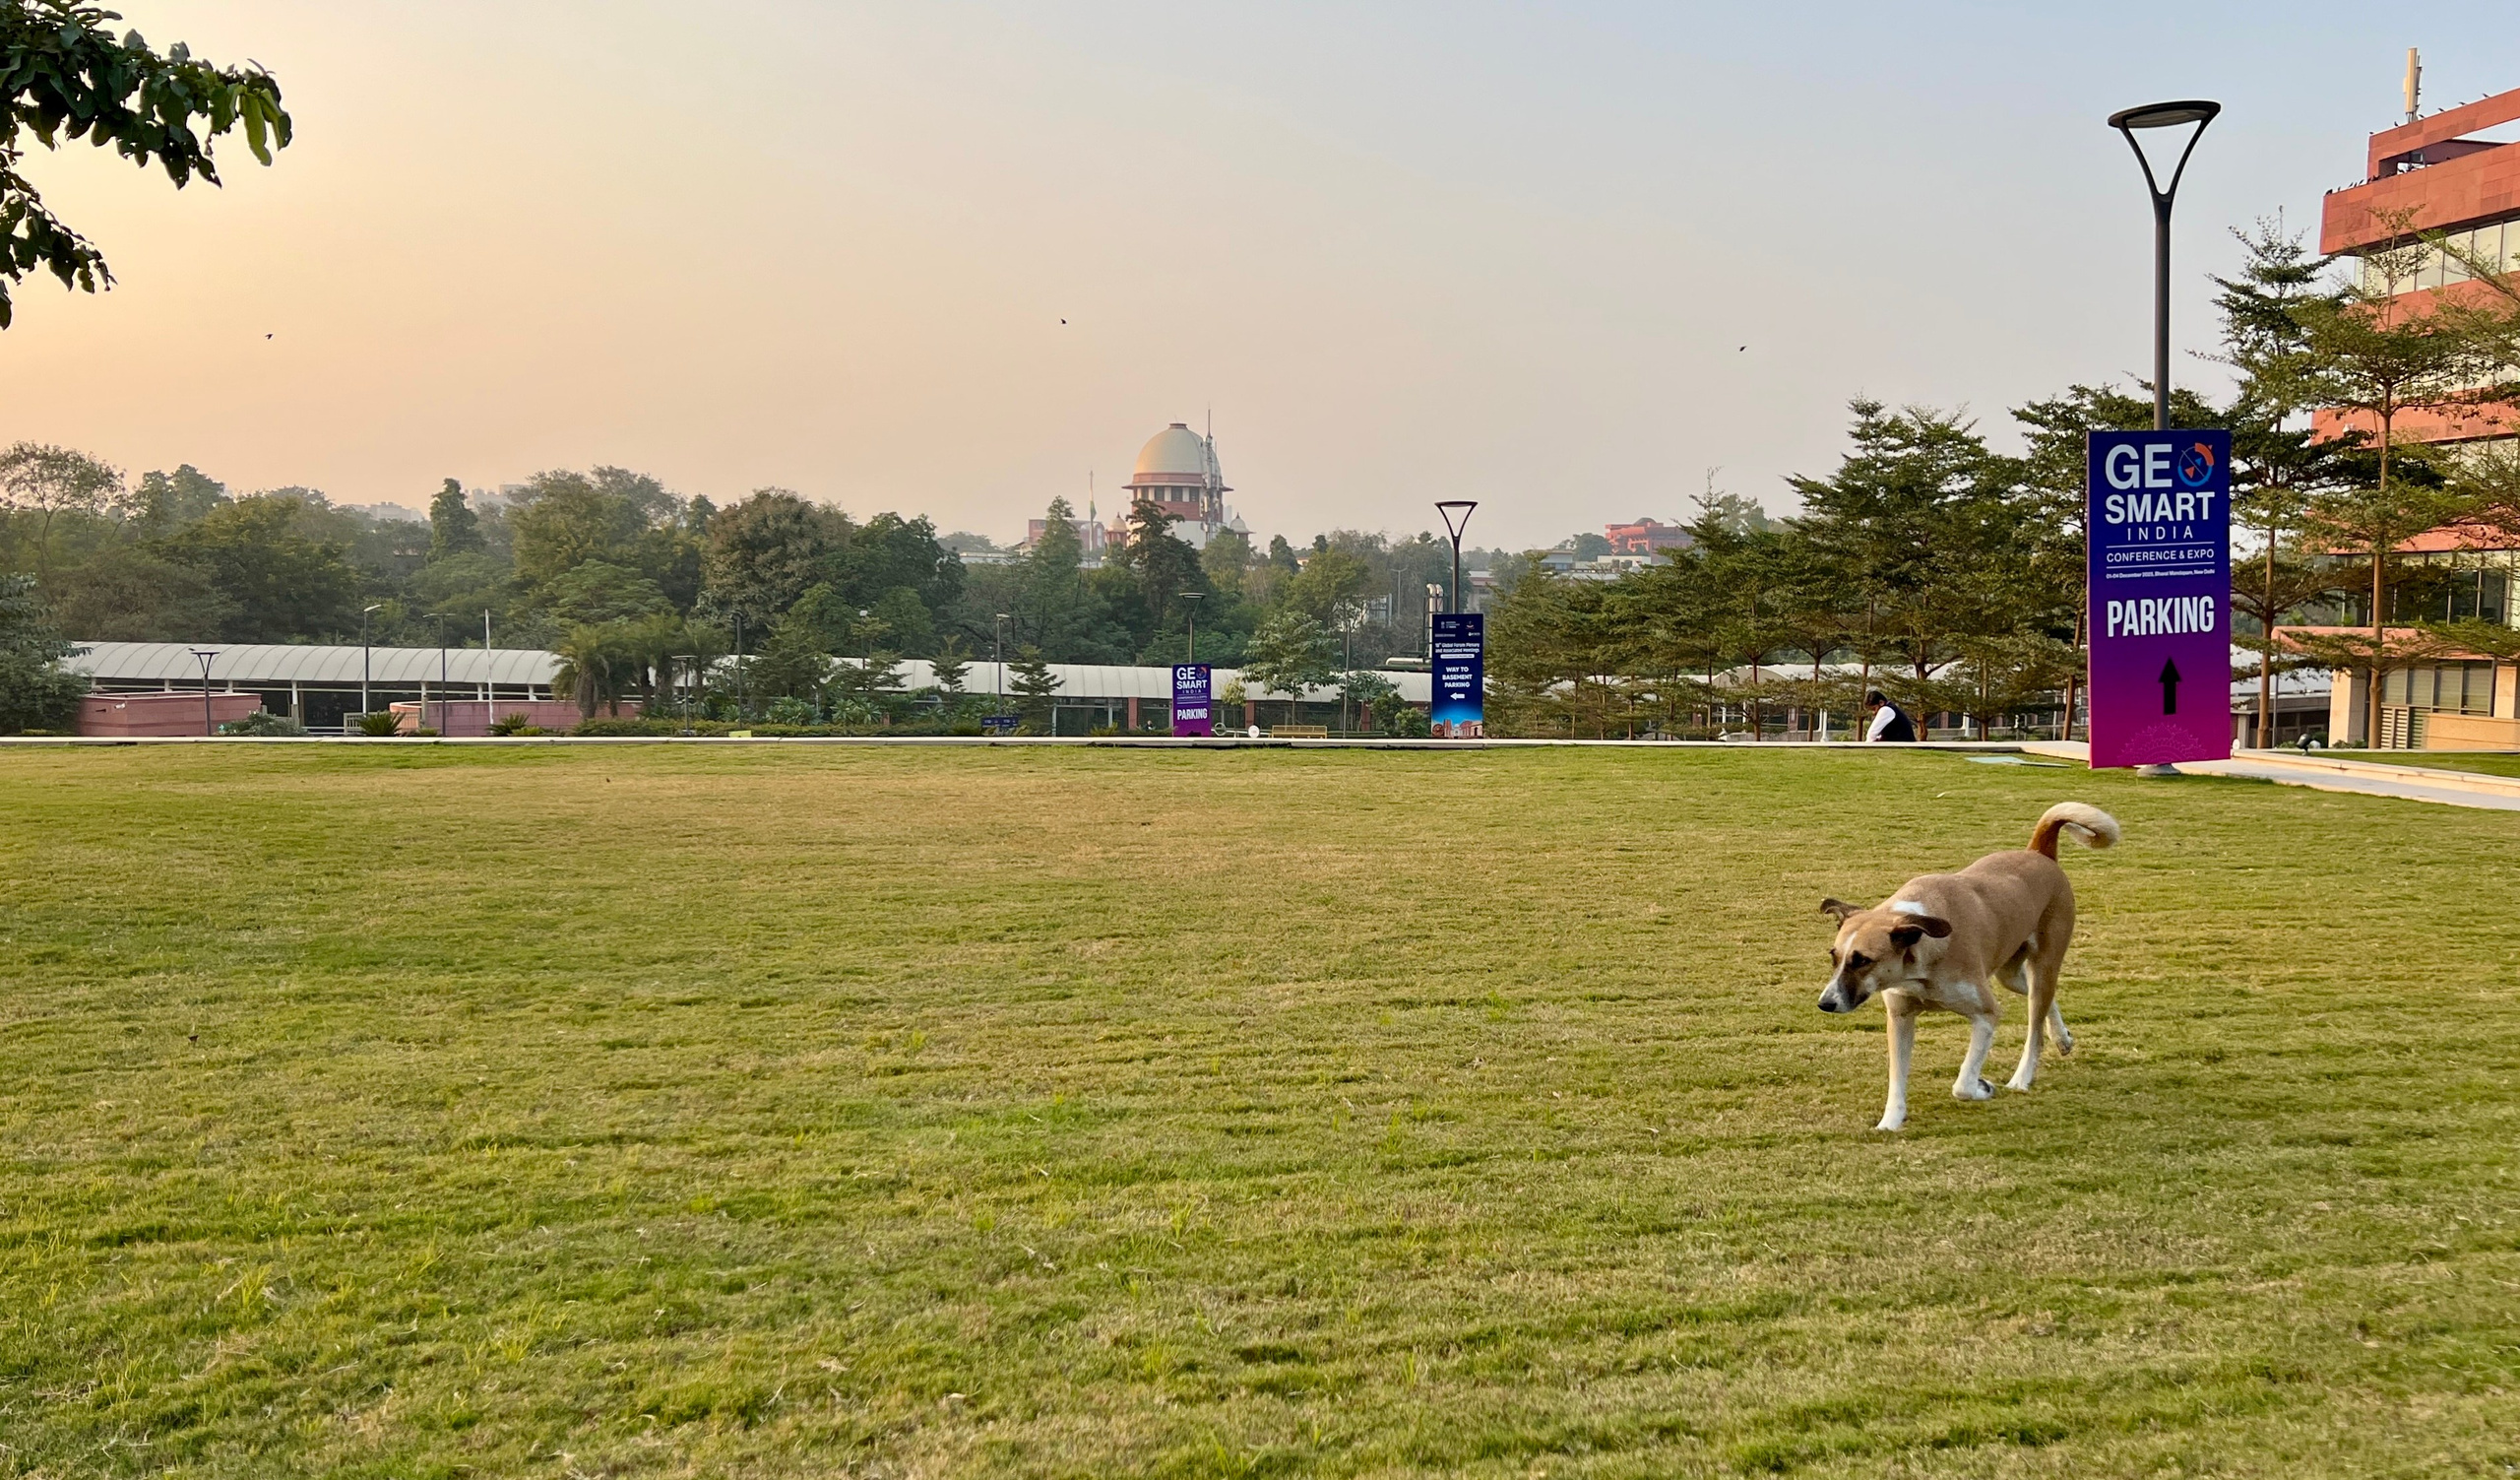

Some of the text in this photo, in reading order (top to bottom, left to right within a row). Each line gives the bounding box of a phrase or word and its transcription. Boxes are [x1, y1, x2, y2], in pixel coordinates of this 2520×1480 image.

[2106, 491, 2215, 524] SMART
[2127, 525, 2193, 541] INDIA
[2107, 548, 2215, 562] CONFERENCE & EXPO
[2108, 596, 2215, 638] PARKING
[1176, 679, 1208, 690] SMART
[1176, 708, 1208, 721] PARKING
